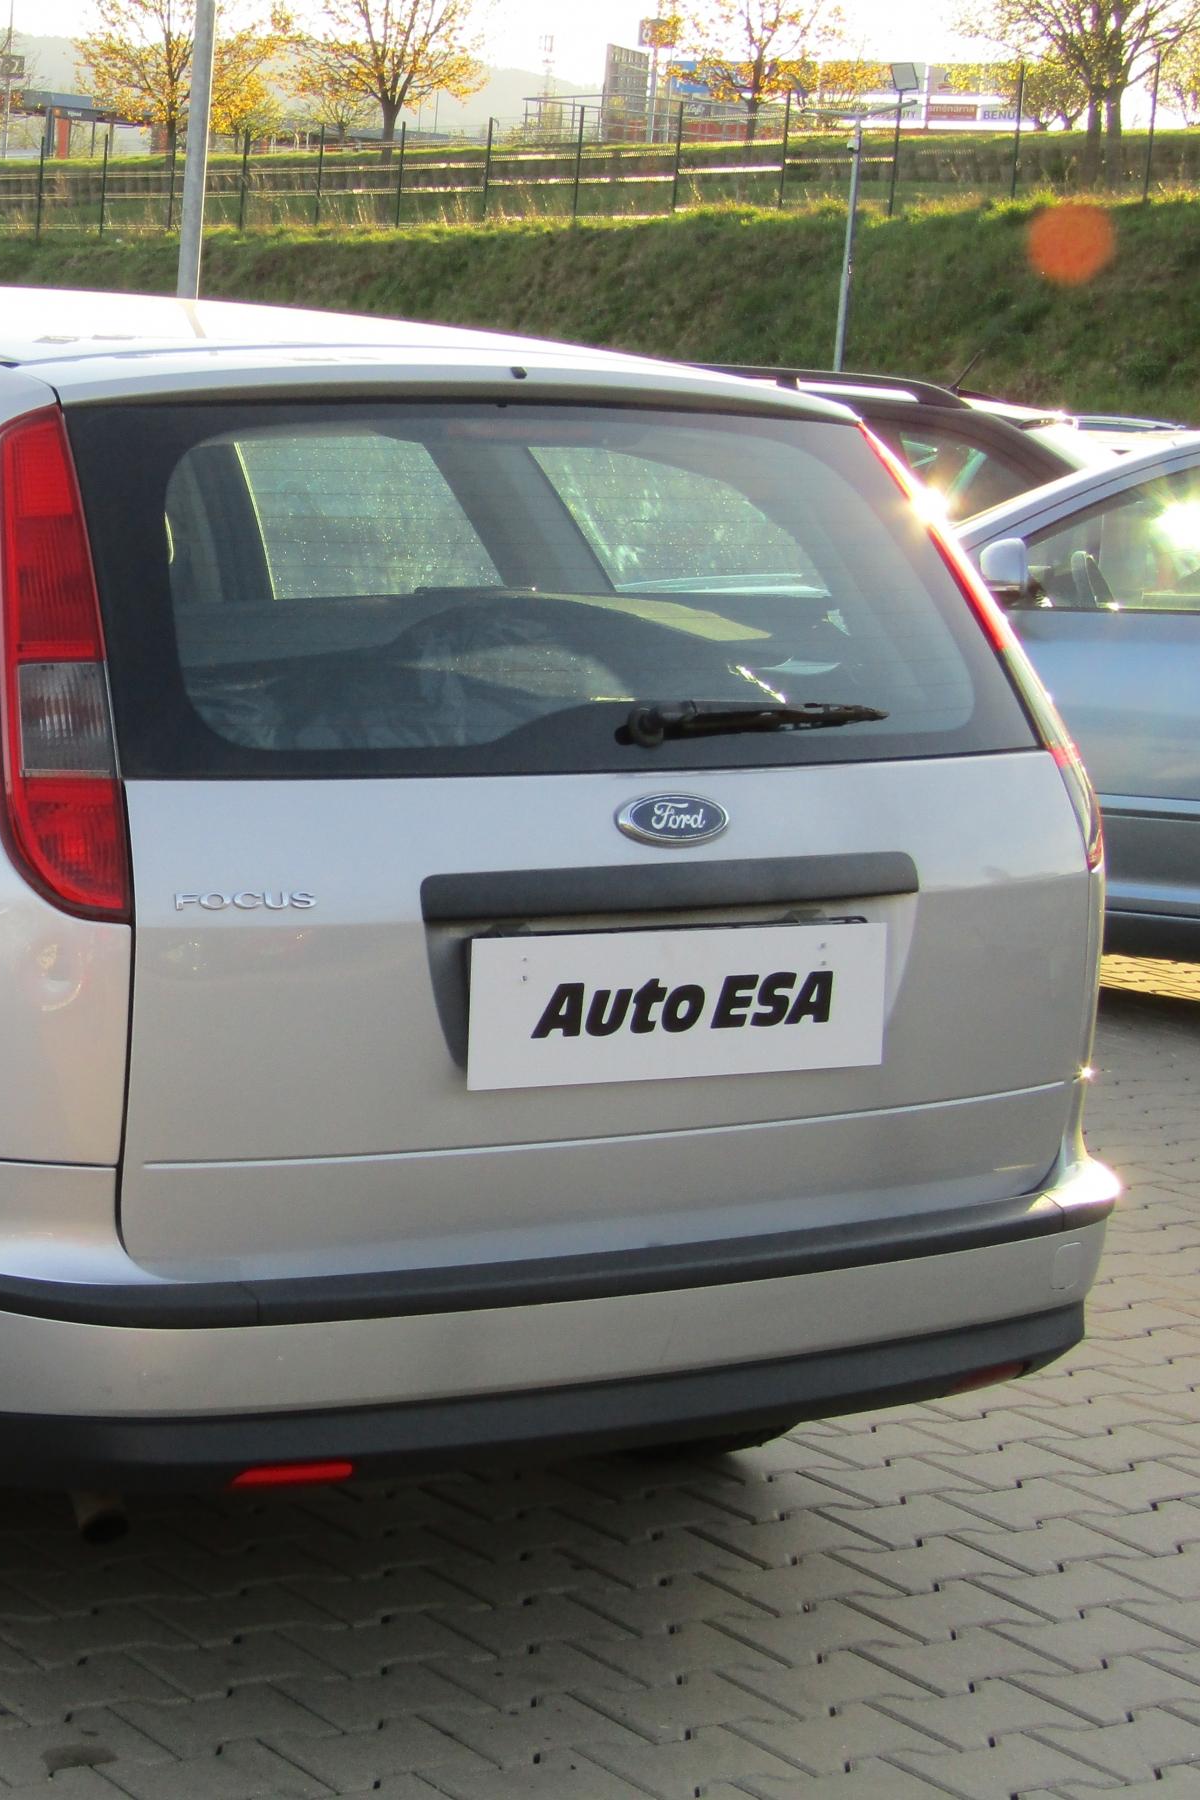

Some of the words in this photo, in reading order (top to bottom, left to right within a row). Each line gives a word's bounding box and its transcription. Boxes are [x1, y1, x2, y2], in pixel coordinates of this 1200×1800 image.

[651, 801, 706, 830] Ford
[174, 890, 318, 912] FOCUS
[530, 977, 706, 1039] Auto
[710, 970, 834, 1030] ESA
